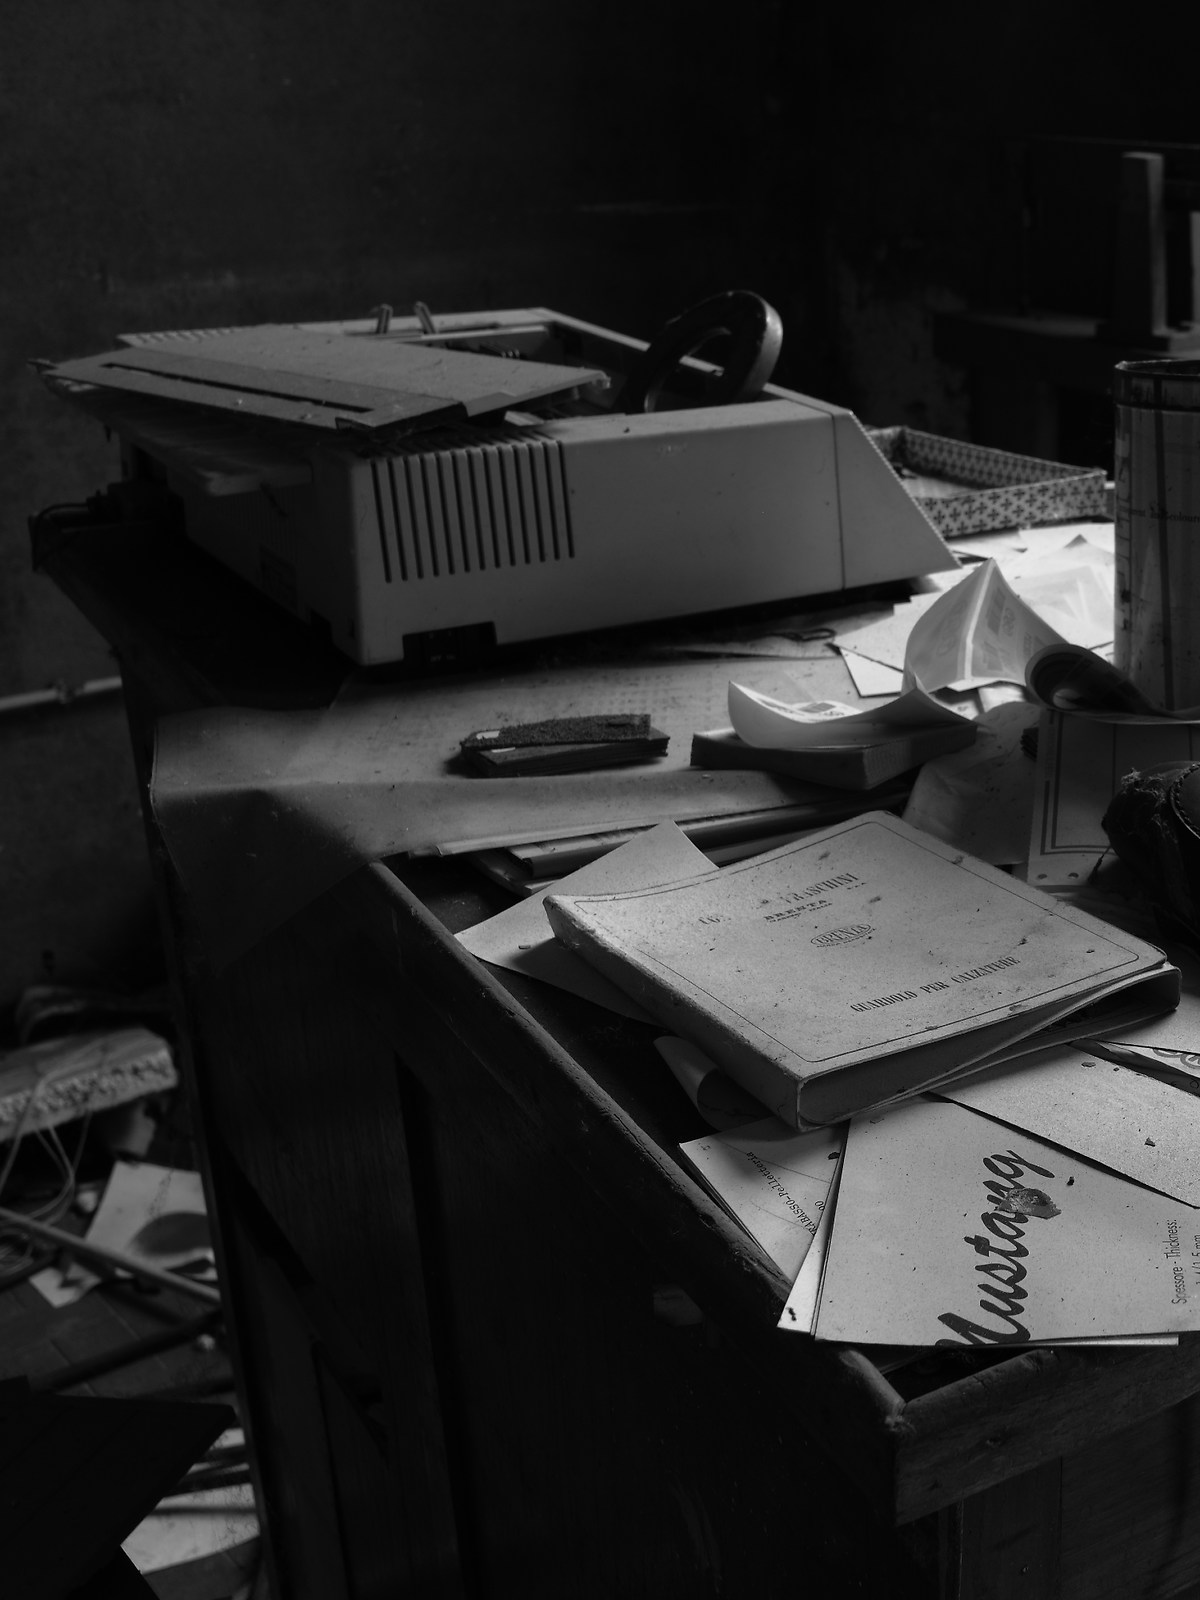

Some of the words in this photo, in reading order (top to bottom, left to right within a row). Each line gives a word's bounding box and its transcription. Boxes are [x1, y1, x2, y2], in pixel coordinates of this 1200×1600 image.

[763, 898, 828, 921] BRENTA
[850, 988, 919, 1014] GUARDOLO
[921, 979, 952, 997] PER
[949, 955, 1022, 986] CALZATURE
[1162, 1218, 1181, 1260] Thickness:
[1170, 1266, 1191, 1305] Spessore
